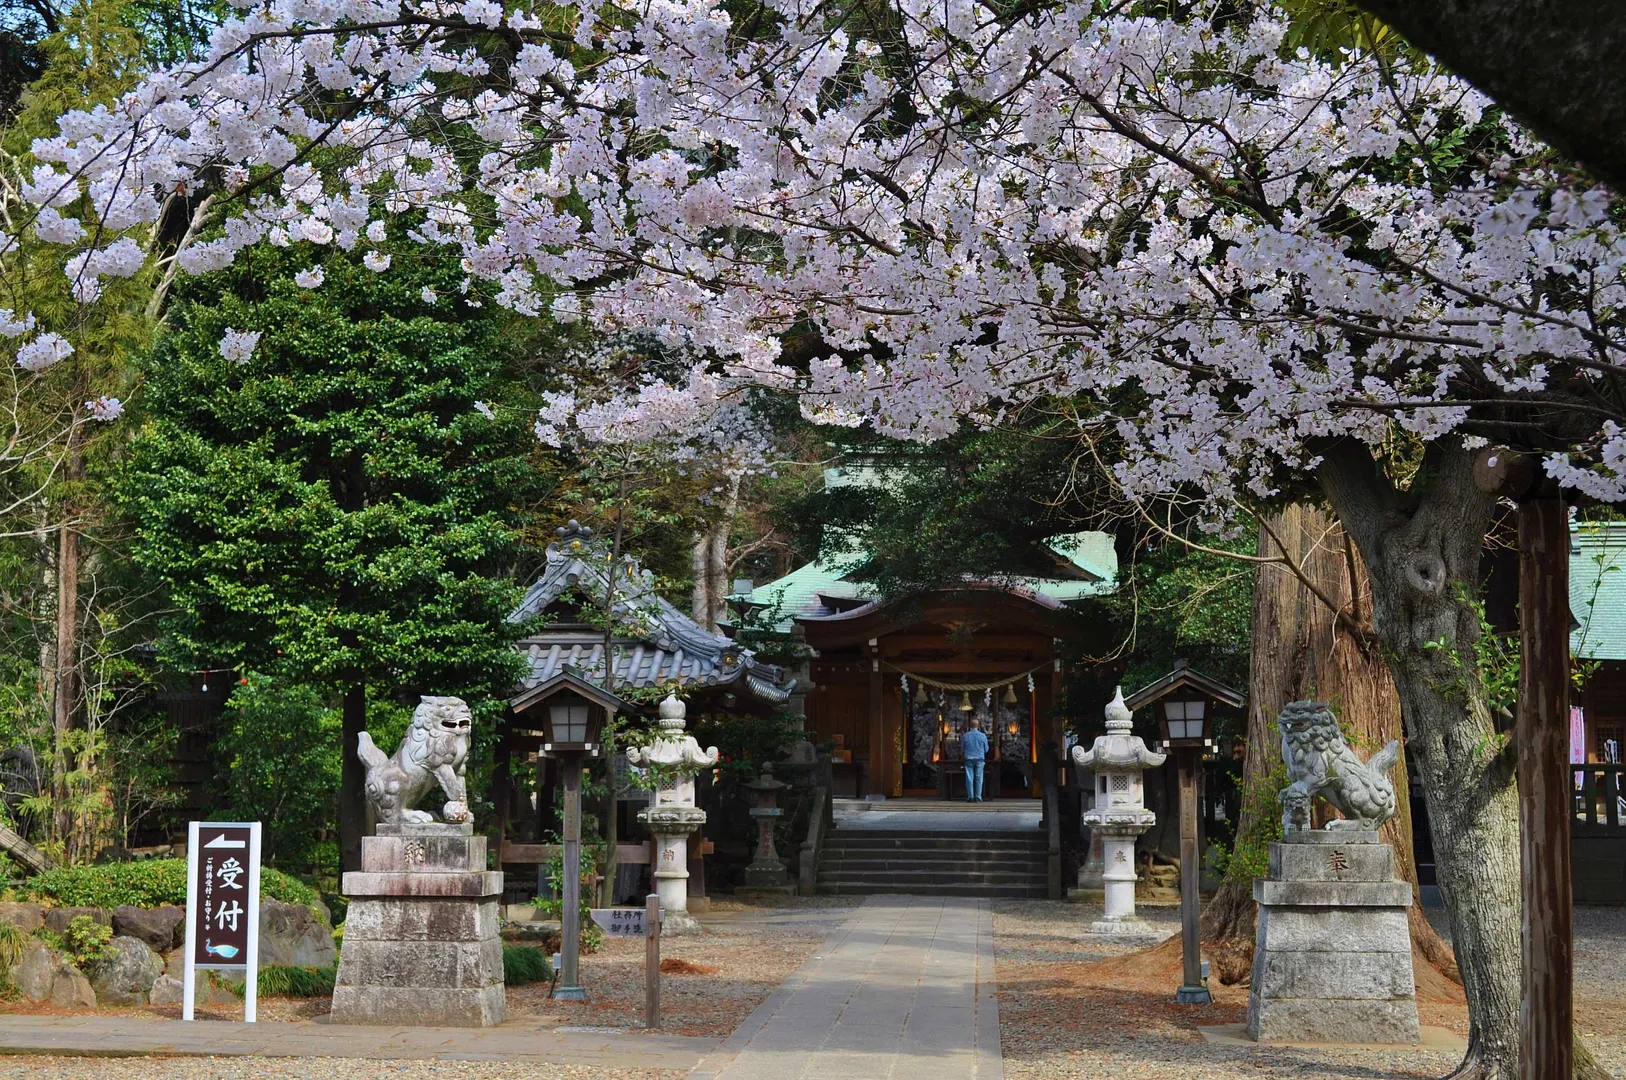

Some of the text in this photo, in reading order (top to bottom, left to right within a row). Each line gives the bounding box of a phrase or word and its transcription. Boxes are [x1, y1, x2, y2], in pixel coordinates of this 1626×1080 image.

[404, 842, 425, 867] 納
[1326, 850, 1349, 873] 奉
[214, 856, 244, 932] 受付
[612, 910, 643, 920] 社務所
[611, 923, 643, 934] 御手洗
